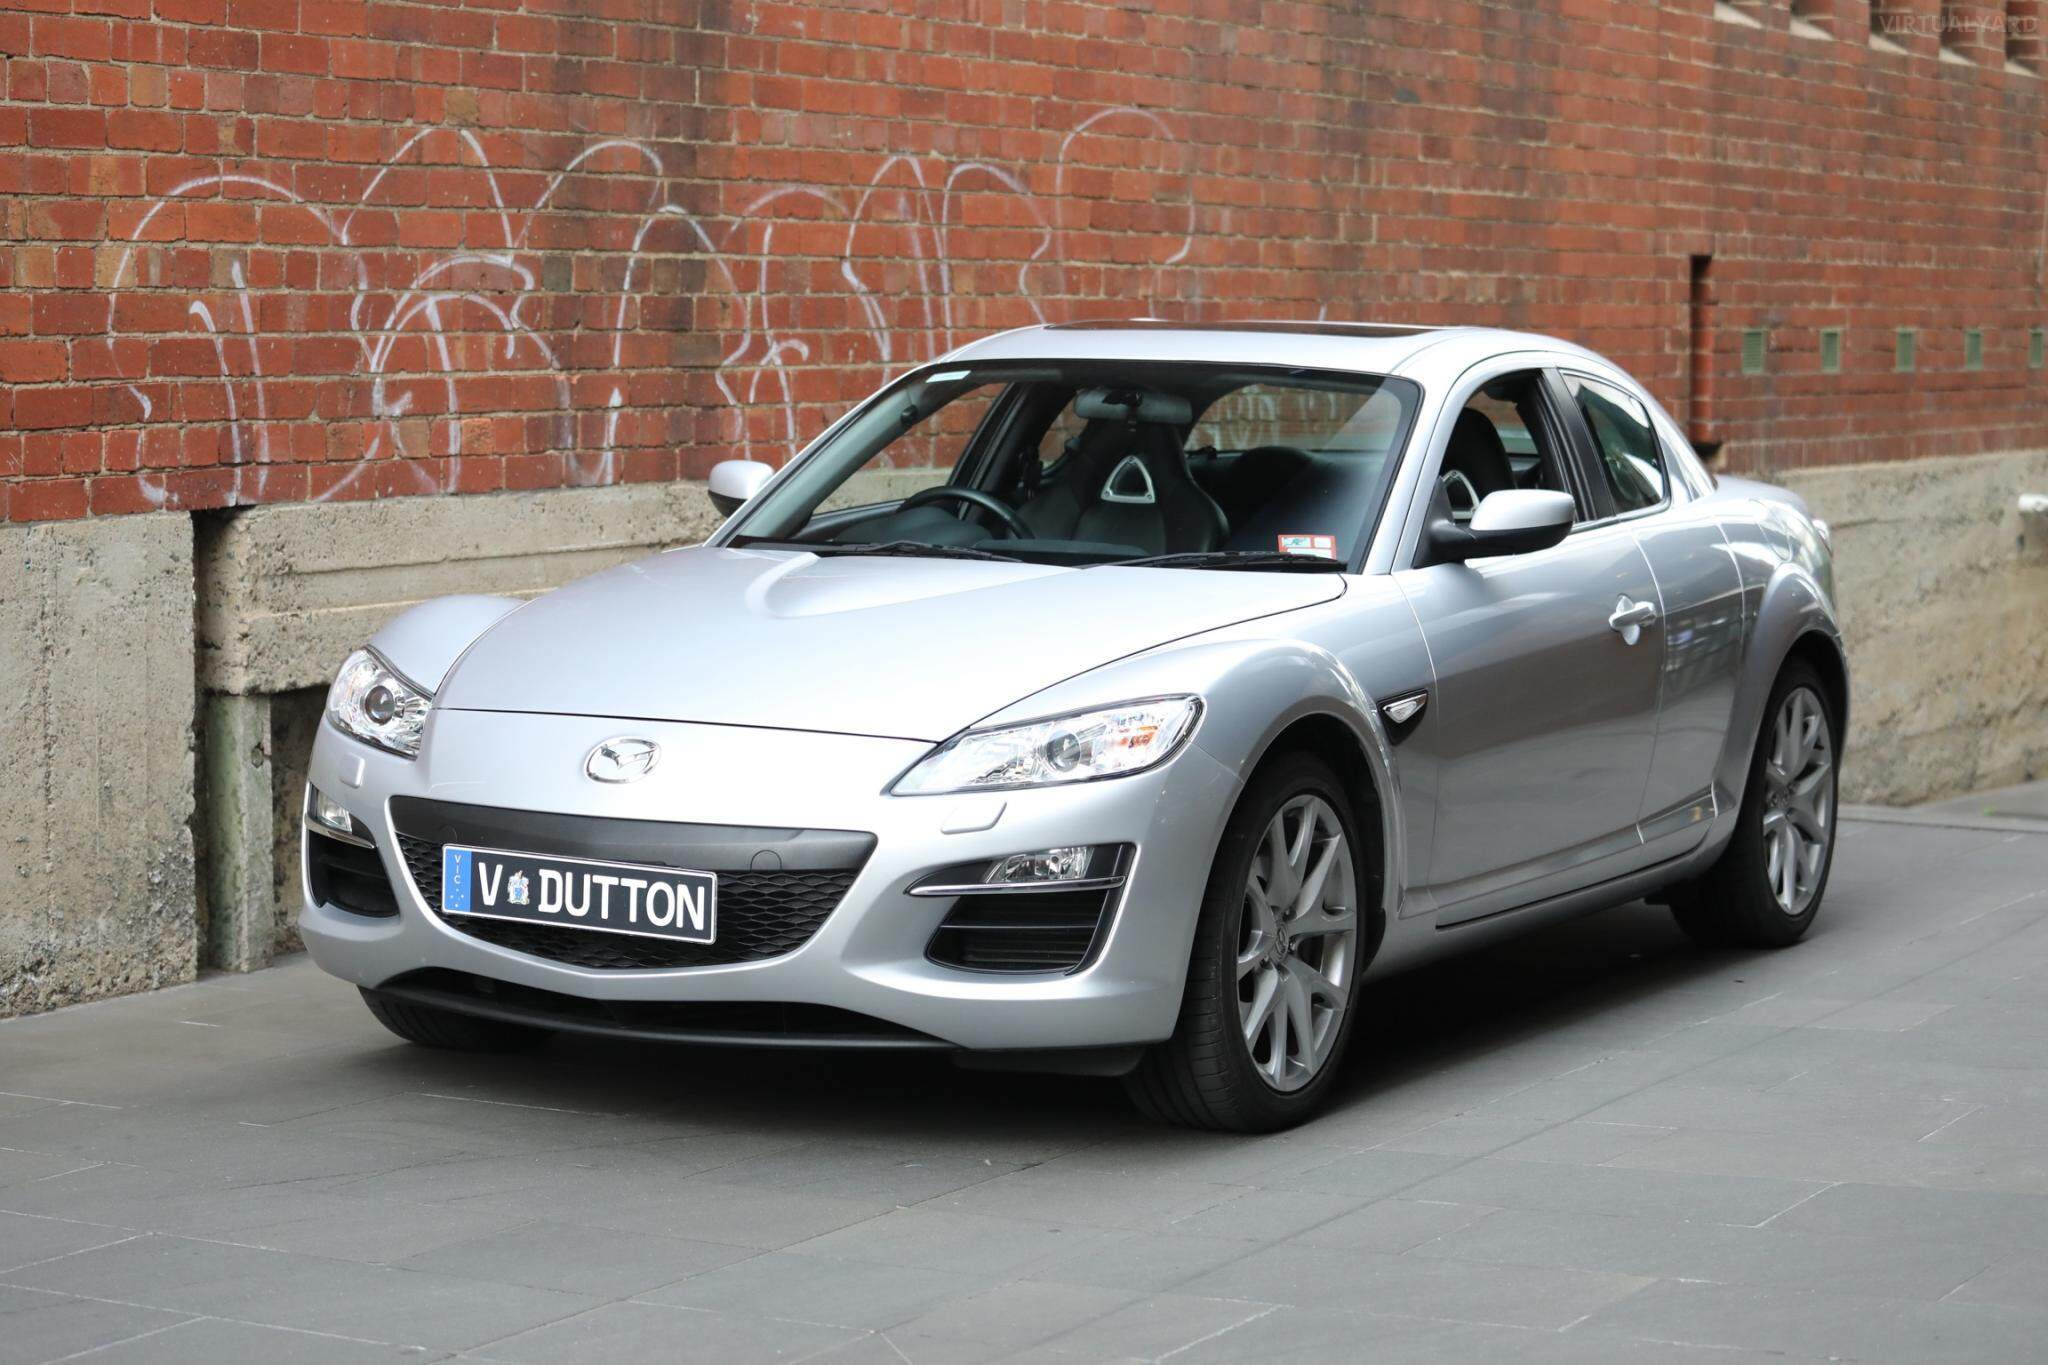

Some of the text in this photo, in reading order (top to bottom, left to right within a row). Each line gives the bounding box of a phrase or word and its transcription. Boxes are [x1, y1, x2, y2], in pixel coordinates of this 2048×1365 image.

[454, 854, 462, 885] VIC
[478, 861, 705, 931] V DUTTON
